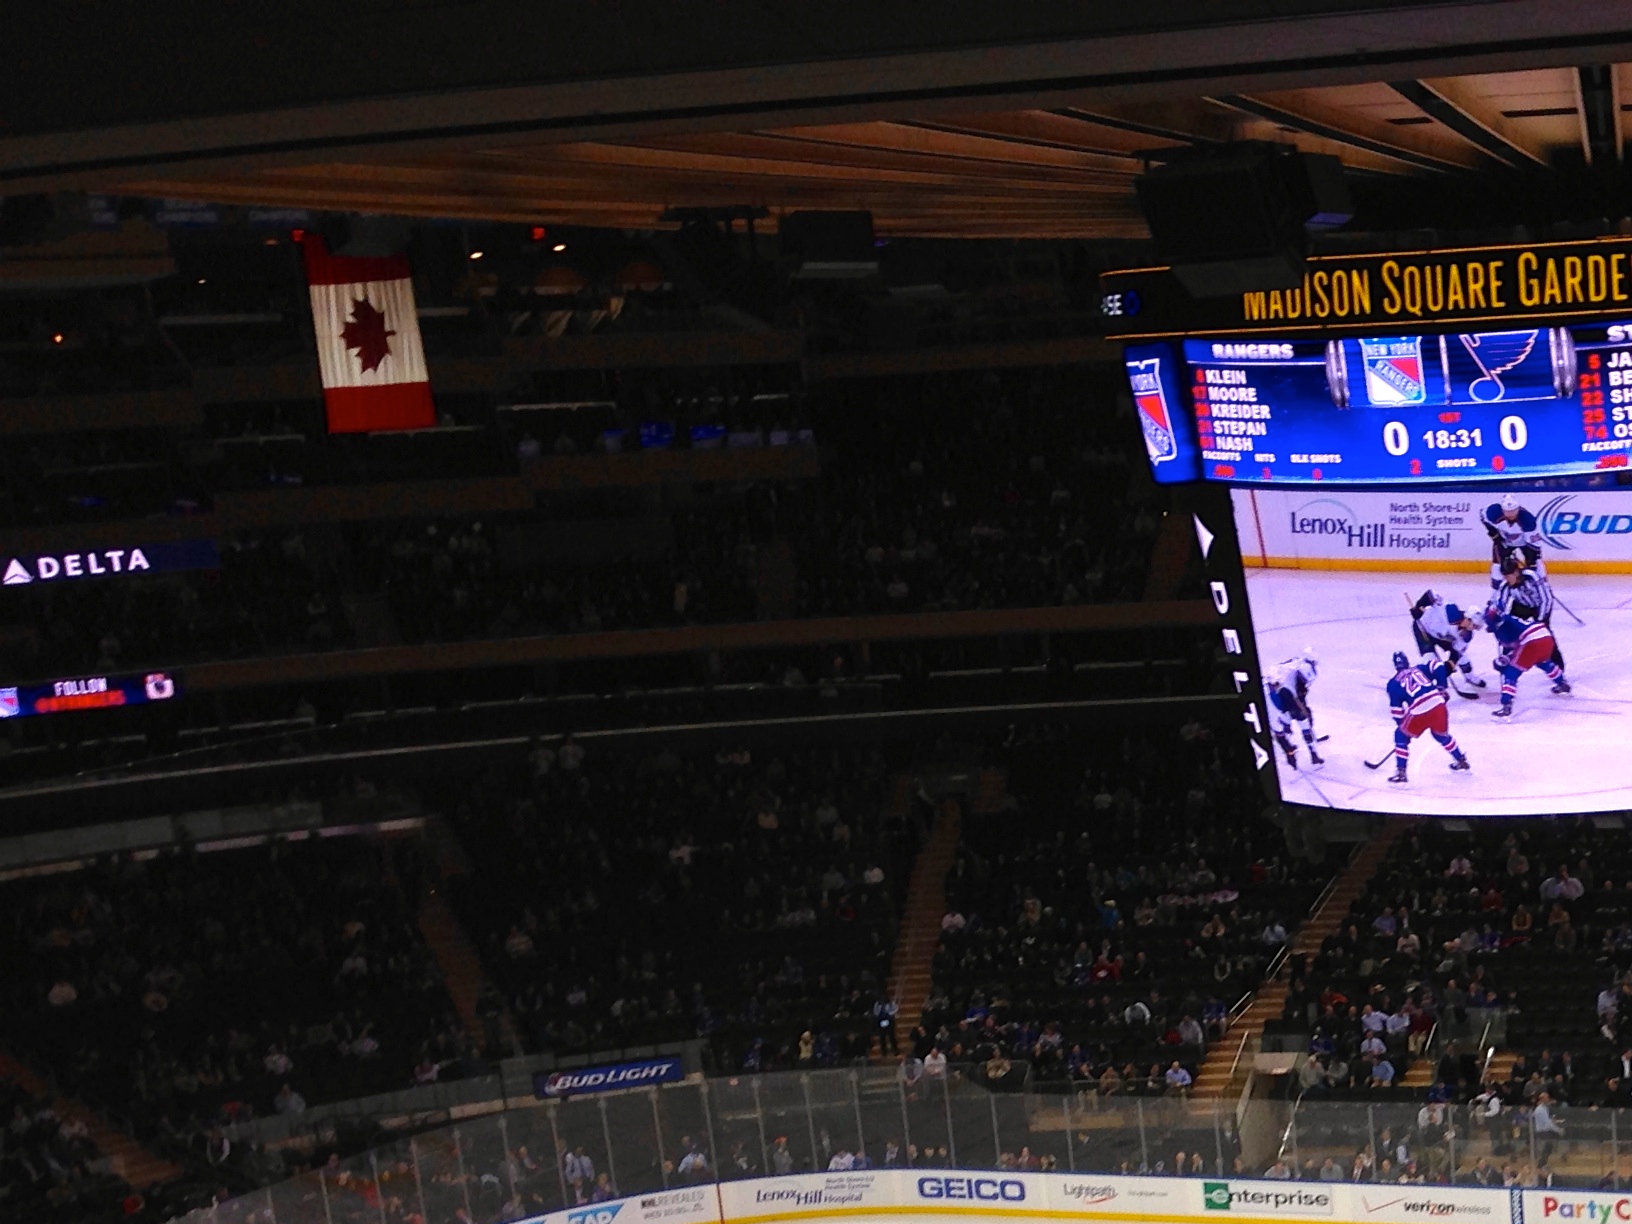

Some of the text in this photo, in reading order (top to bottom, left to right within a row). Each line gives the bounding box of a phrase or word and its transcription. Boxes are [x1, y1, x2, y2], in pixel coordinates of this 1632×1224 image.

[1382, 259, 1507, 317] SQUARE
[1212, 344, 1294, 359] RANGERS
[1205, 370, 1247, 384] KLEIN
[1208, 387, 1257, 402] MOORE
[1211, 403, 1271, 419] KREIDER
[1213, 421, 1267, 435] STEPAN
[1500, 415, 1528, 451] 0
[1216, 437, 1253, 451] NASH
[1383, 421, 1410, 456] 0
[1423, 428, 1483, 449] 18:31
[1436, 457, 1477, 468] SHOTS
[1290, 512, 1386, 547] Lenox Hill
[1389, 515, 1464, 527] Health System
[1389, 532, 1451, 552] Hospital
[37, 548, 150, 579] DELTA
[1401, 671, 1431, 694] 20
[608, 1063, 673, 1083] LIGHT
[756, 1188, 797, 1203] Lenox
[917, 1177, 1026, 1201] GEICO
[1212, 1186, 1330, 1210] enterprise
[1404, 1199, 1455, 1216] verizon
